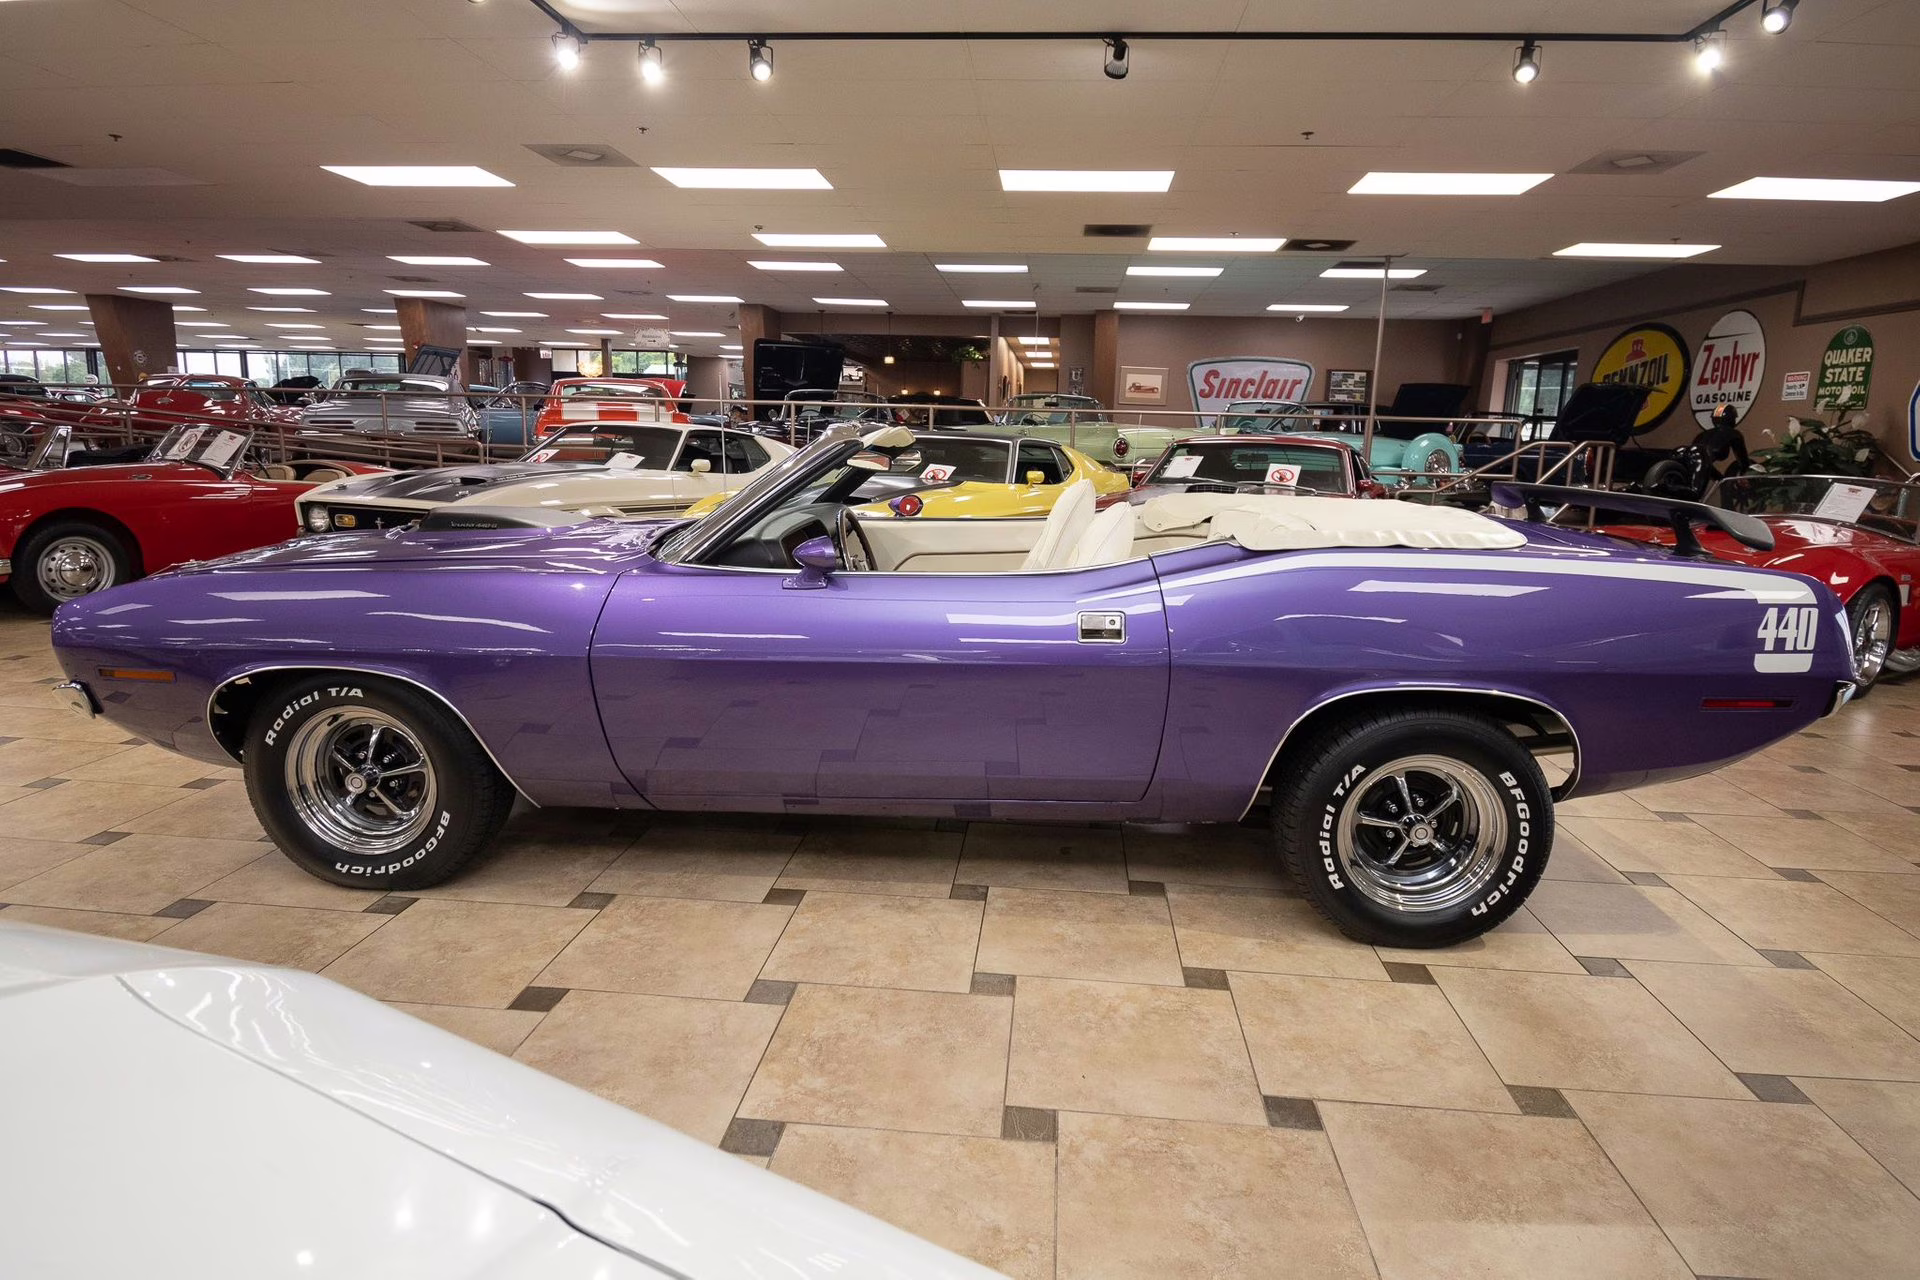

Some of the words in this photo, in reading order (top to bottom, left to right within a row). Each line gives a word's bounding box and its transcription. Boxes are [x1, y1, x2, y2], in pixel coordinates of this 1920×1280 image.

[1697, 341, 1760, 391] Zephyr
[1824, 347, 1872, 366] QUAKER
[1824, 367, 1865, 383] STATE
[1199, 369, 1302, 399] Sinclair
[1696, 391, 1751, 404] GASOLINE
[1818, 386, 1844, 395] MOTO
[1851, 385, 1865, 394] OIL
[1758, 608, 1818, 651] 440
[264, 691, 320, 746] Radial
[327, 687, 364, 698] T/A
[335, 810, 450, 877] BFGoodrich
[1319, 804, 1345, 890] Radial
[1333, 764, 1367, 798] T/A
[1471, 771, 1529, 917] BFGoodrich
